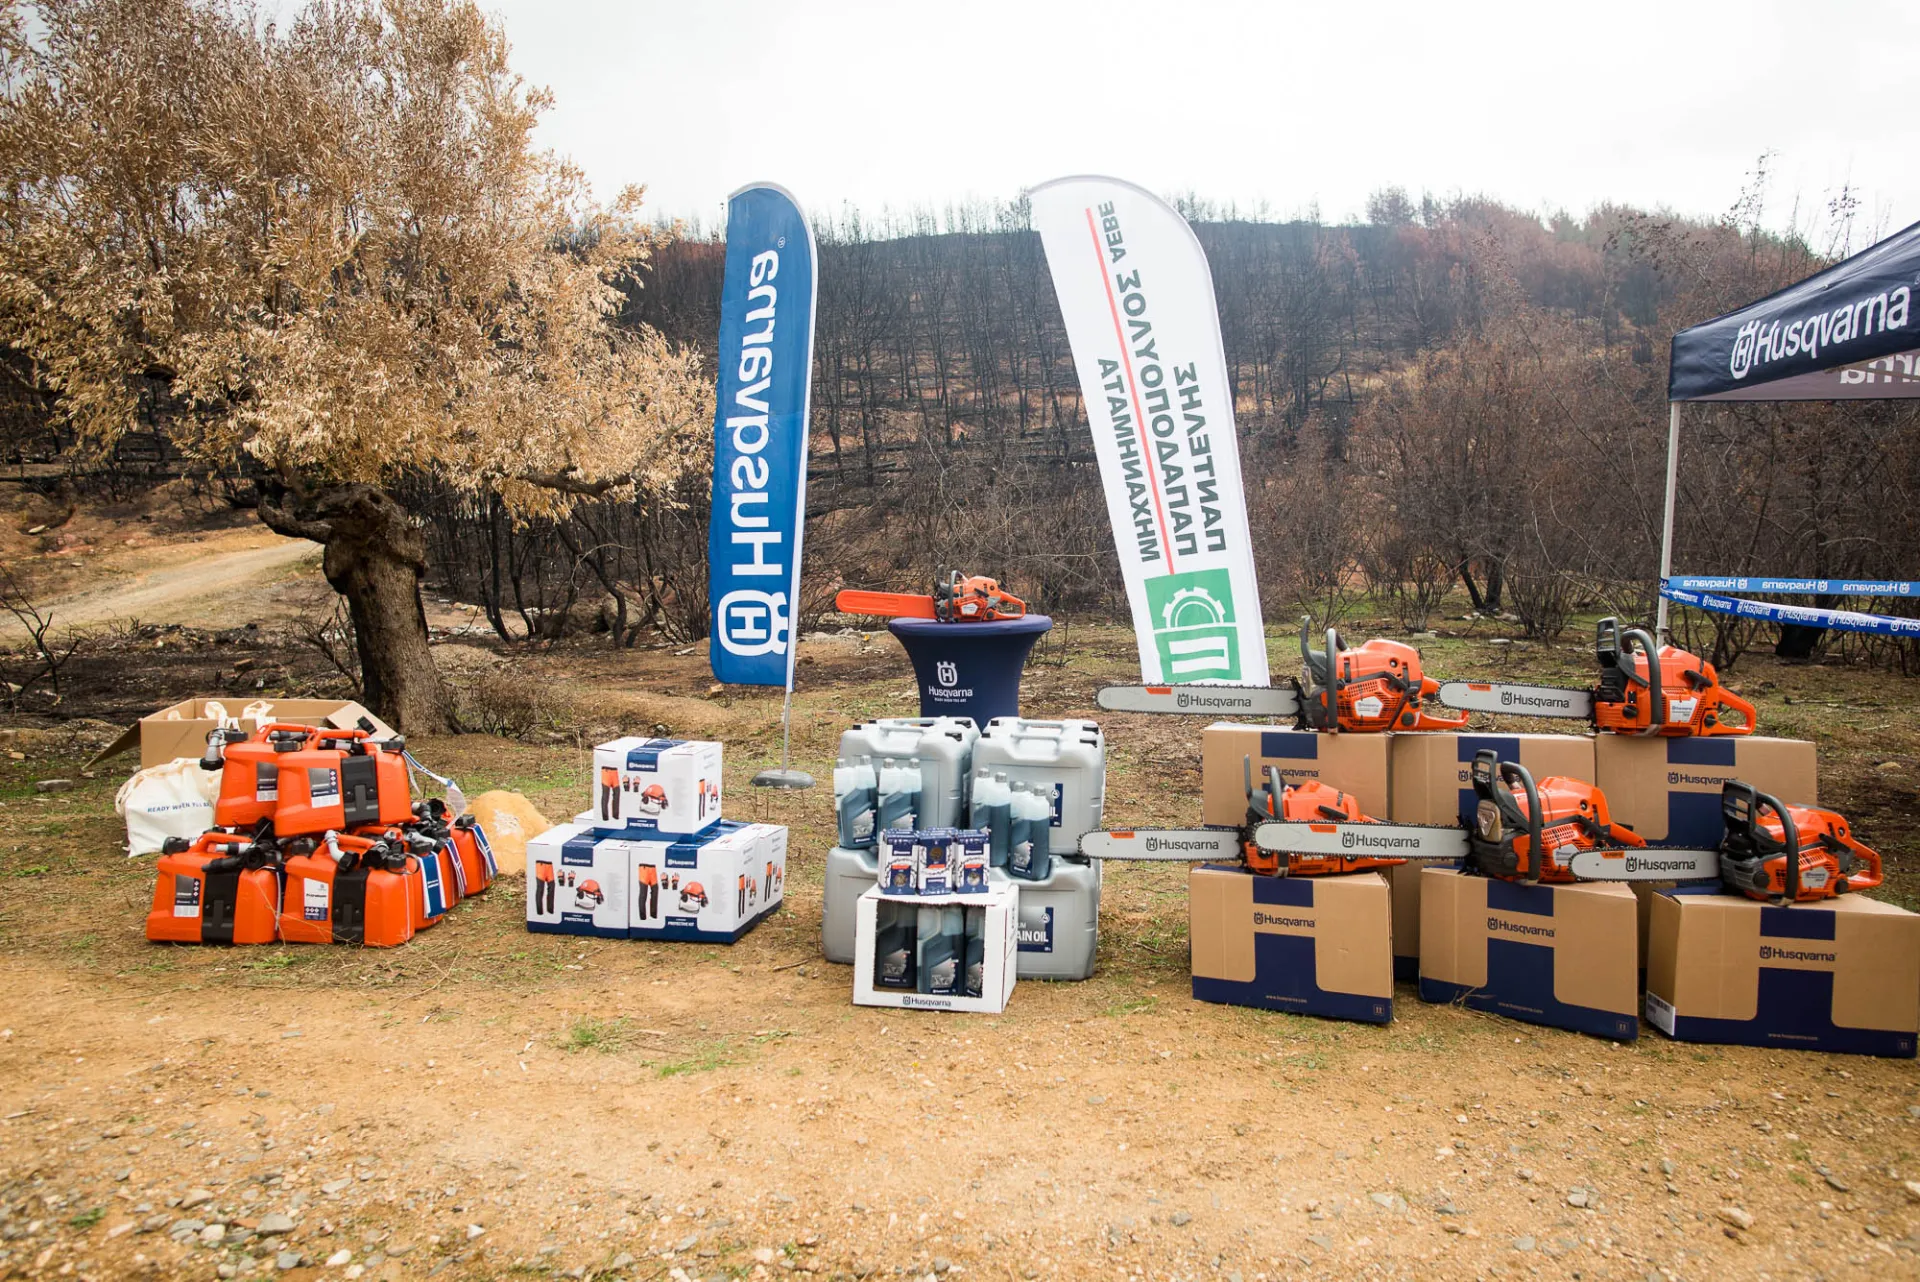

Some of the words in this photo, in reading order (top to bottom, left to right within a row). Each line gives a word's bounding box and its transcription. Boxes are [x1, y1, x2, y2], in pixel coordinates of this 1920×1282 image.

[1754, 286, 1910, 366] Husqvarna
[928, 685, 973, 698] Husqvarna
[1190, 695, 1251, 708] Husqvarna
[1513, 693, 1570, 709] Husqvarna
[1276, 768, 1319, 778] usqvarna
[1159, 839, 1219, 851] Husqvarna
[1355, 834, 1420, 848] Husqvarna
[1638, 858, 1696, 871] Husqvarna
[1264, 914, 1315, 928] Husqvarna
[1498, 920, 1555, 937] Husqvarna
[1033, 931, 1049, 943] OIL
[1772, 948, 1836, 962] Husqvarna
[911, 997, 952, 1007] Husqvarna
